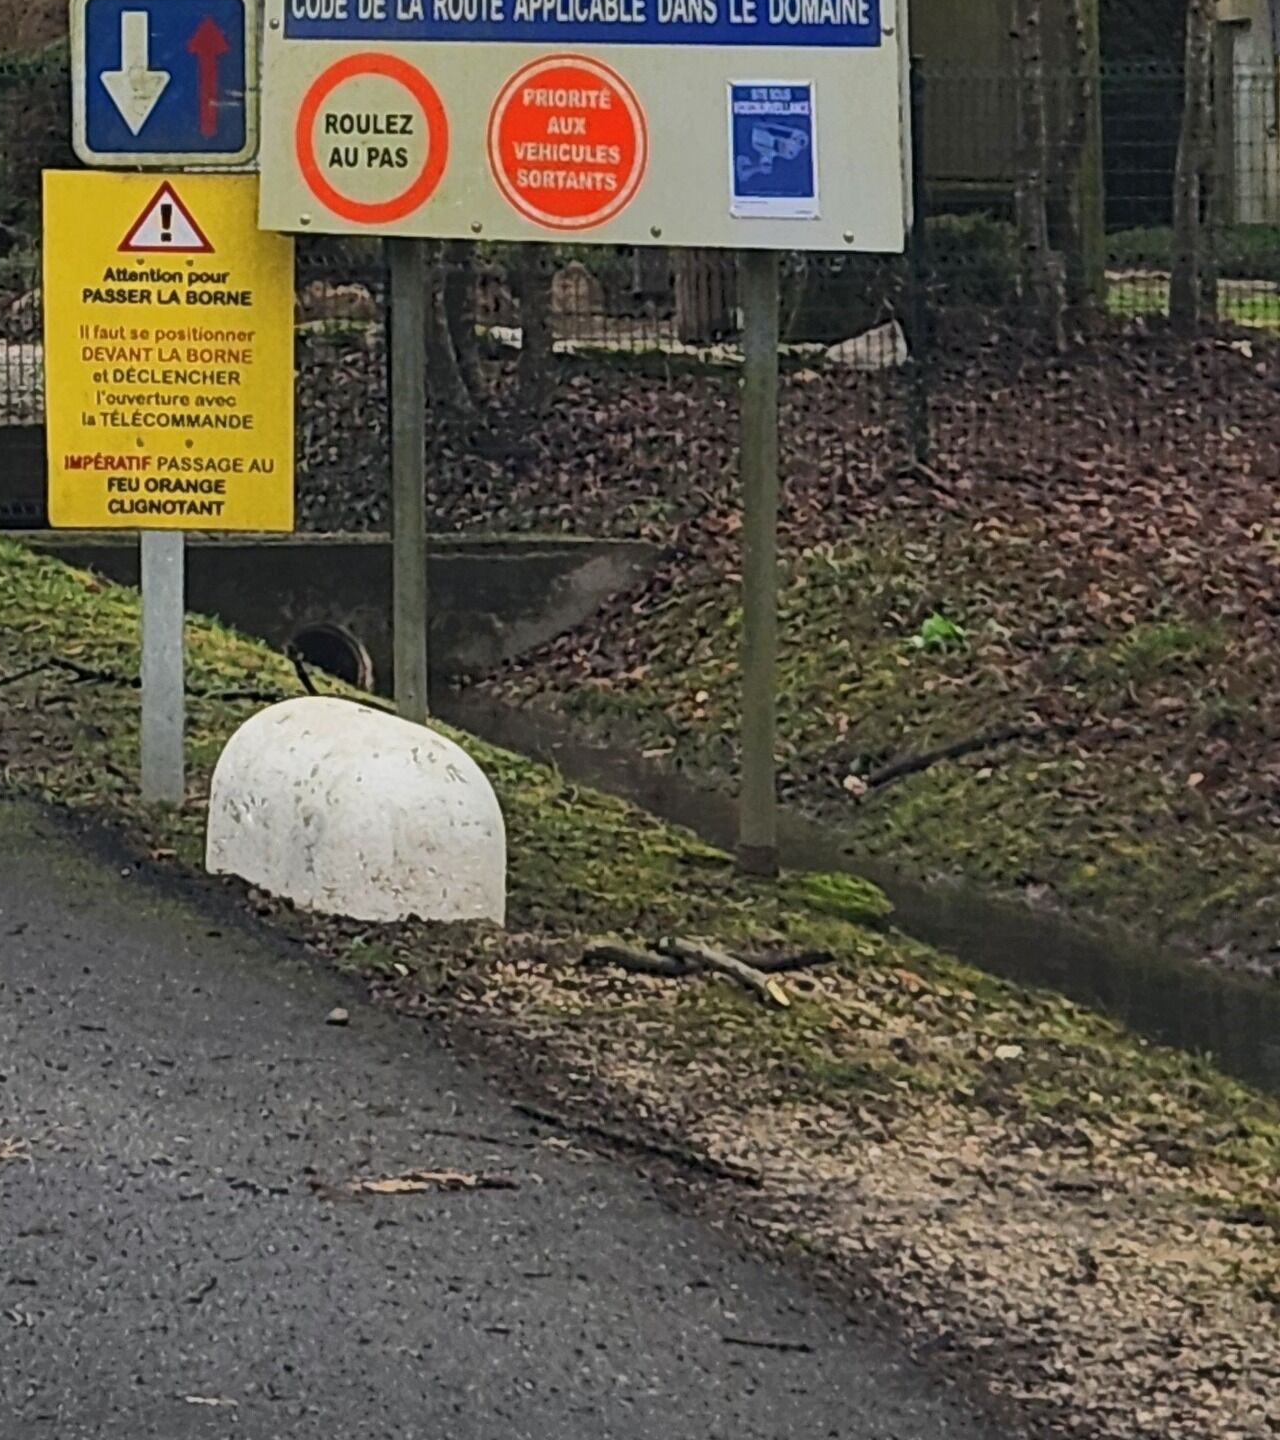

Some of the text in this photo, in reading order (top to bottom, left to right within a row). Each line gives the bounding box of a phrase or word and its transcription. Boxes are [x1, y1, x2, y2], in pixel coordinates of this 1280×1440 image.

[522, 86, 612, 110] PRIORITÉ
[323, 112, 414, 136] ROULEZ
[546, 116, 587, 136] AUX
[328, 146, 410, 169] AU PAS
[515, 168, 618, 192] SORTANTS
[102, 266, 231, 288] Attention pour
[81, 287, 253, 307] PASSER LA BORNE
[79, 324, 256, 345] Il faut se positionner
[81, 346, 254, 365] DEVANT LA BORNE
[92, 367, 242, 386] et DÉCLENCHER
[95, 389, 237, 408] l'ouverture avec
[81, 408, 255, 430] la TÉLÉCOMMANDE
[63, 451, 275, 474] IMPÉRATIF PASSAGE AU
[106, 476, 227, 495] FEU ORANGE
[106, 498, 226, 517] CLIGNOTANT
